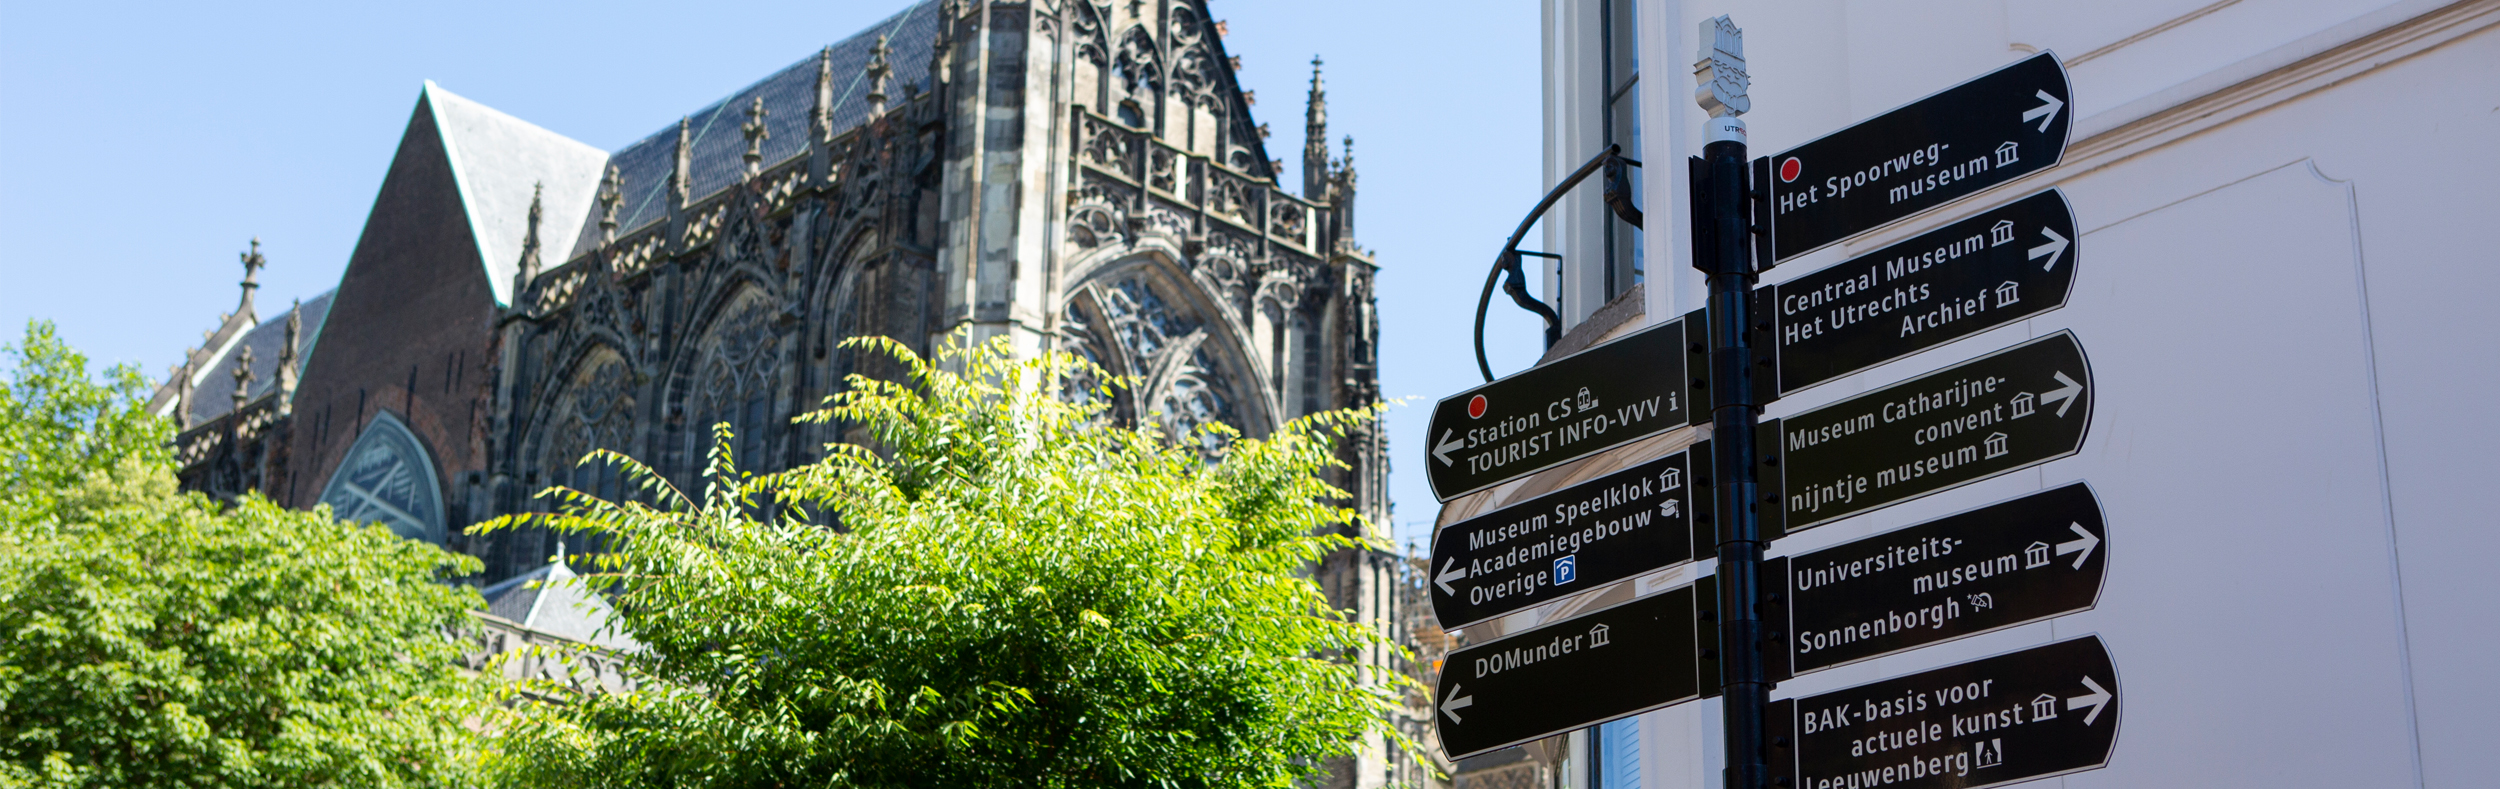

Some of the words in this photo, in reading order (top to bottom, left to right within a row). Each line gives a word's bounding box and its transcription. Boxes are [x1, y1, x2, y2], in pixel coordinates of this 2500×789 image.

[1780, 185, 1818, 215] Het
[1826, 143, 1949, 199] Spoorweg-
[1889, 155, 1988, 205] museum
[1784, 265, 1877, 316] Centraal
[1886, 234, 1984, 282] Museum
[1785, 316, 1823, 346] Het
[1831, 283, 1930, 330] Utrechts
[1900, 288, 1987, 338] Archief
[1467, 412, 1540, 449] Station
[1547, 397, 1572, 422] CS
[1467, 430, 1553, 475] TOURIST
[1559, 395, 1661, 447] INFO-VVV
[1789, 413, 1875, 452] Museum
[1882, 376, 2006, 423] Catharijne-
[1914, 402, 2003, 446] convent
[1791, 474, 1867, 513] nijntje
[1877, 445, 1977, 488] museum
[1469, 513, 1548, 551] Museum
[1555, 476, 1653, 526] Speelklok
[1469, 509, 1652, 579] Academiegebouw
[1798, 537, 1963, 591] Universiteits-
[1470, 570, 1547, 606] Overige
[1913, 553, 2018, 595] museum
[1800, 596, 1960, 654] Sonnenborgh
[1475, 634, 1583, 679] DOMunder
[1804, 689, 1927, 735] BAK-basis
[1935, 678, 1993, 707] voor
[1851, 720, 1942, 757] actuele
[1952, 703, 2024, 738] kunst
